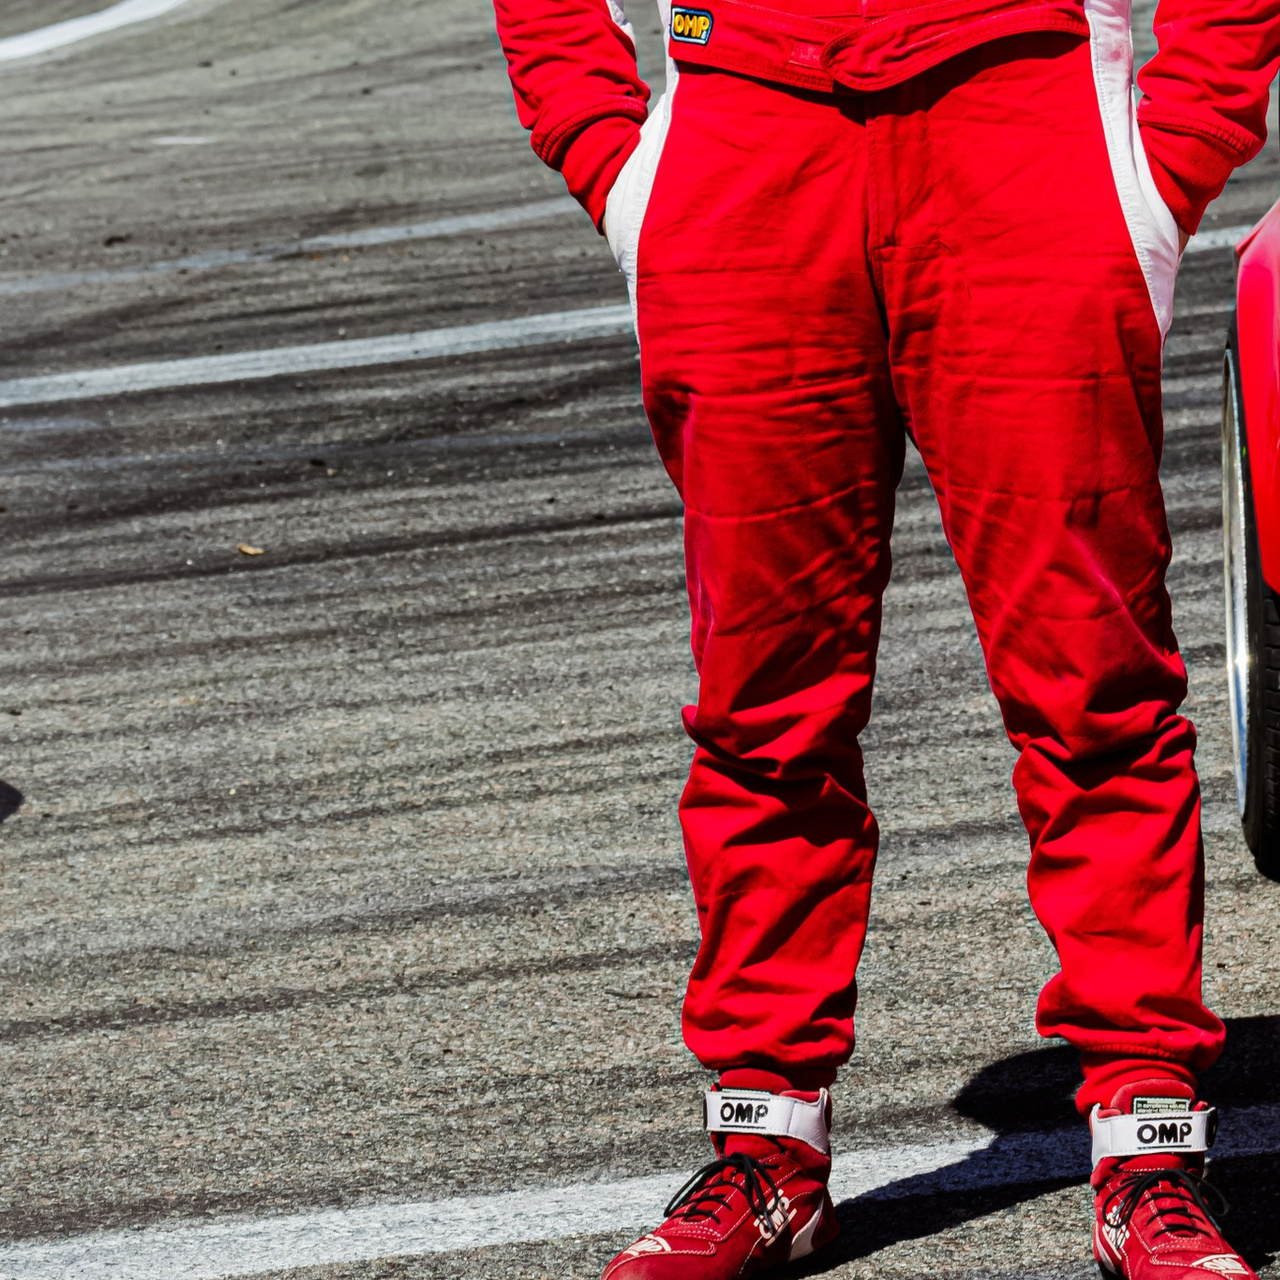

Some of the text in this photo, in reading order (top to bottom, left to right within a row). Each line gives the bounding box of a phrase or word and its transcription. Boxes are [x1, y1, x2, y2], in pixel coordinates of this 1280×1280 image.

[673, 14, 710, 38] OMP
[720, 1102, 769, 1124] OMP
[1136, 1122, 1193, 1144] OMP
